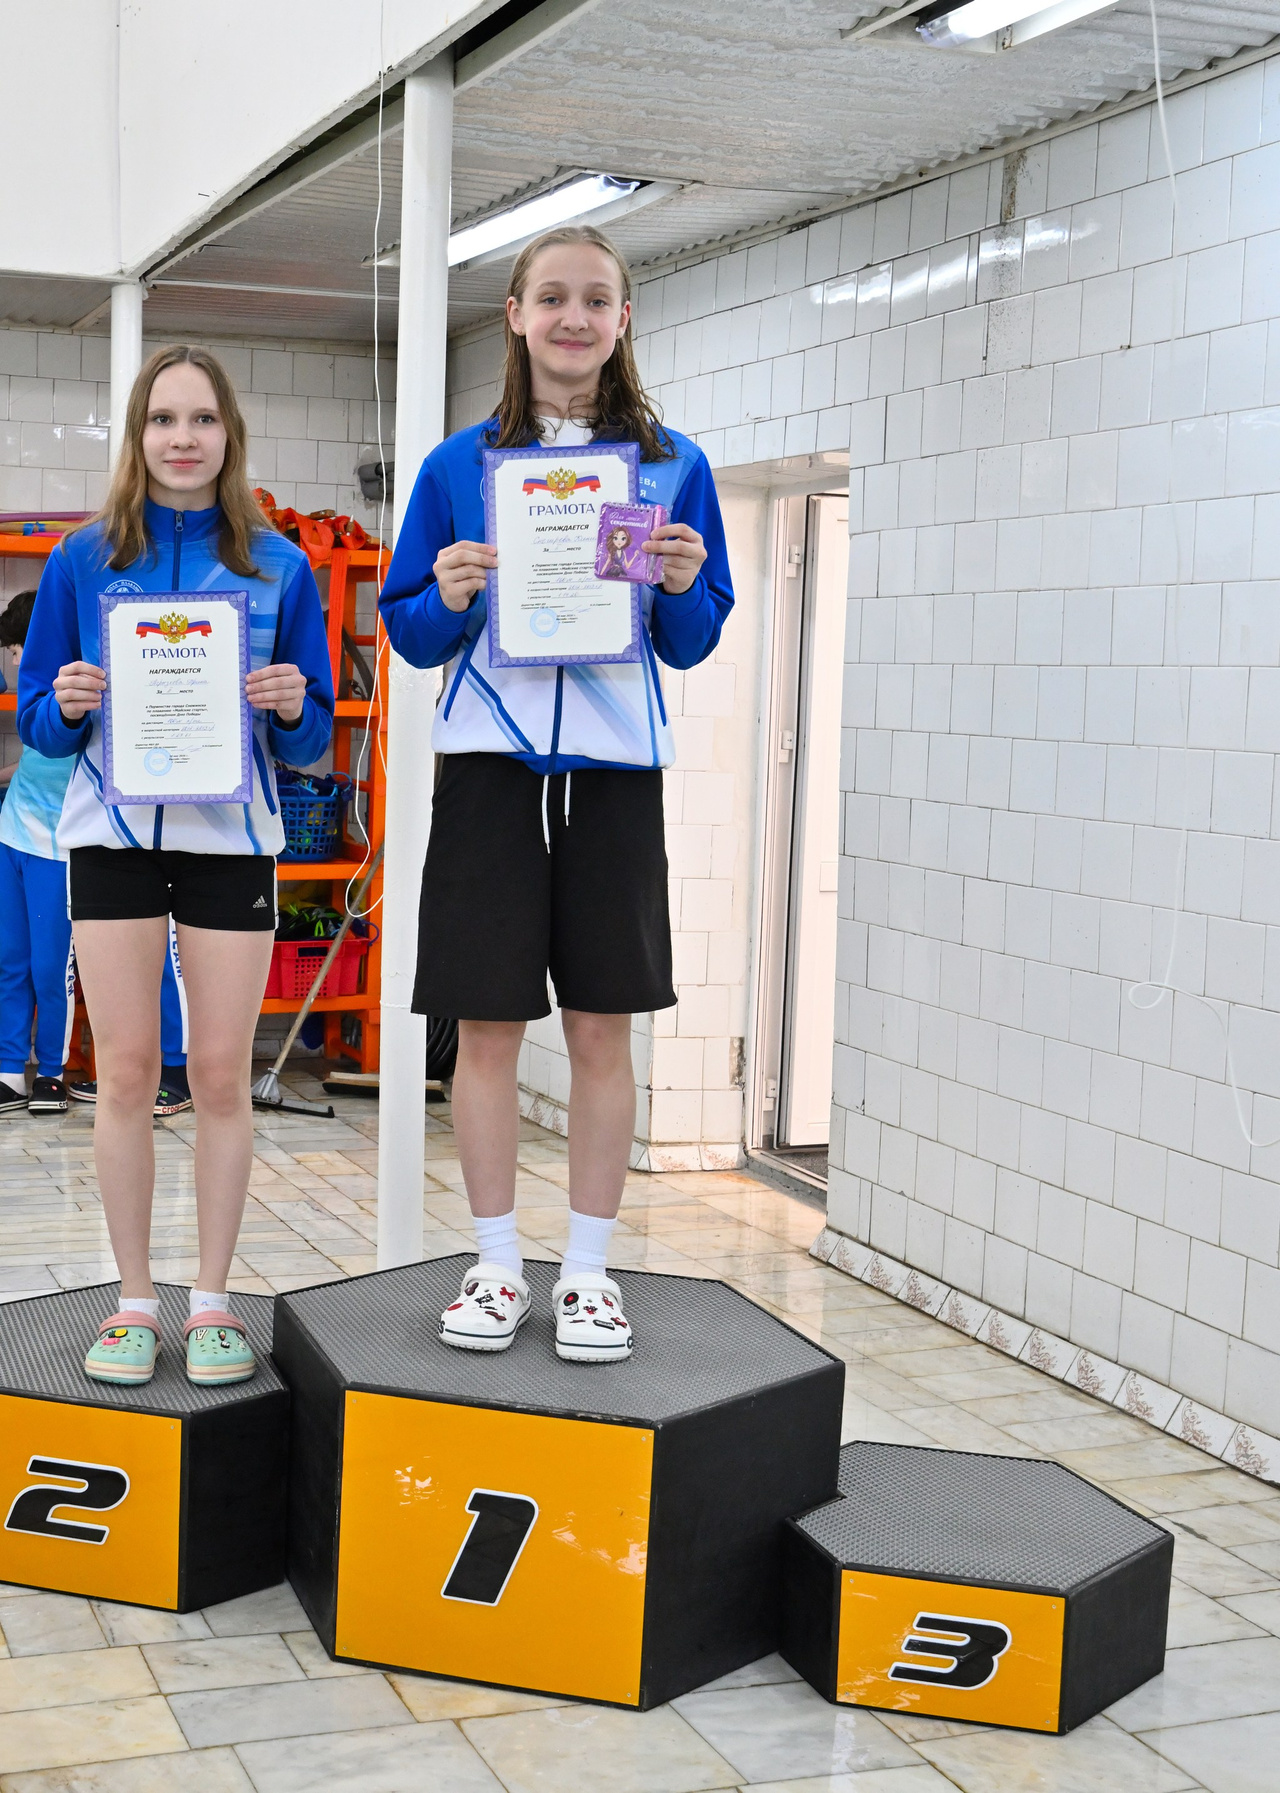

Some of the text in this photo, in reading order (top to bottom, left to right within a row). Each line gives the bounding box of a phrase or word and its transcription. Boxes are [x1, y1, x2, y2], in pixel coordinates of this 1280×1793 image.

[529, 503, 595, 516] ГРАМОТА
[535, 524, 589, 532] НАГРАЖДАЕТСЯ
[142, 647, 207, 659] ГРАМОТА
[148, 667, 201, 675] НАГРАЖДАЕТСЯ
[5, 1455, 130, 1545] 2
[440, 1488, 539, 1607] 1
[885, 1612, 1012, 1690] 3
